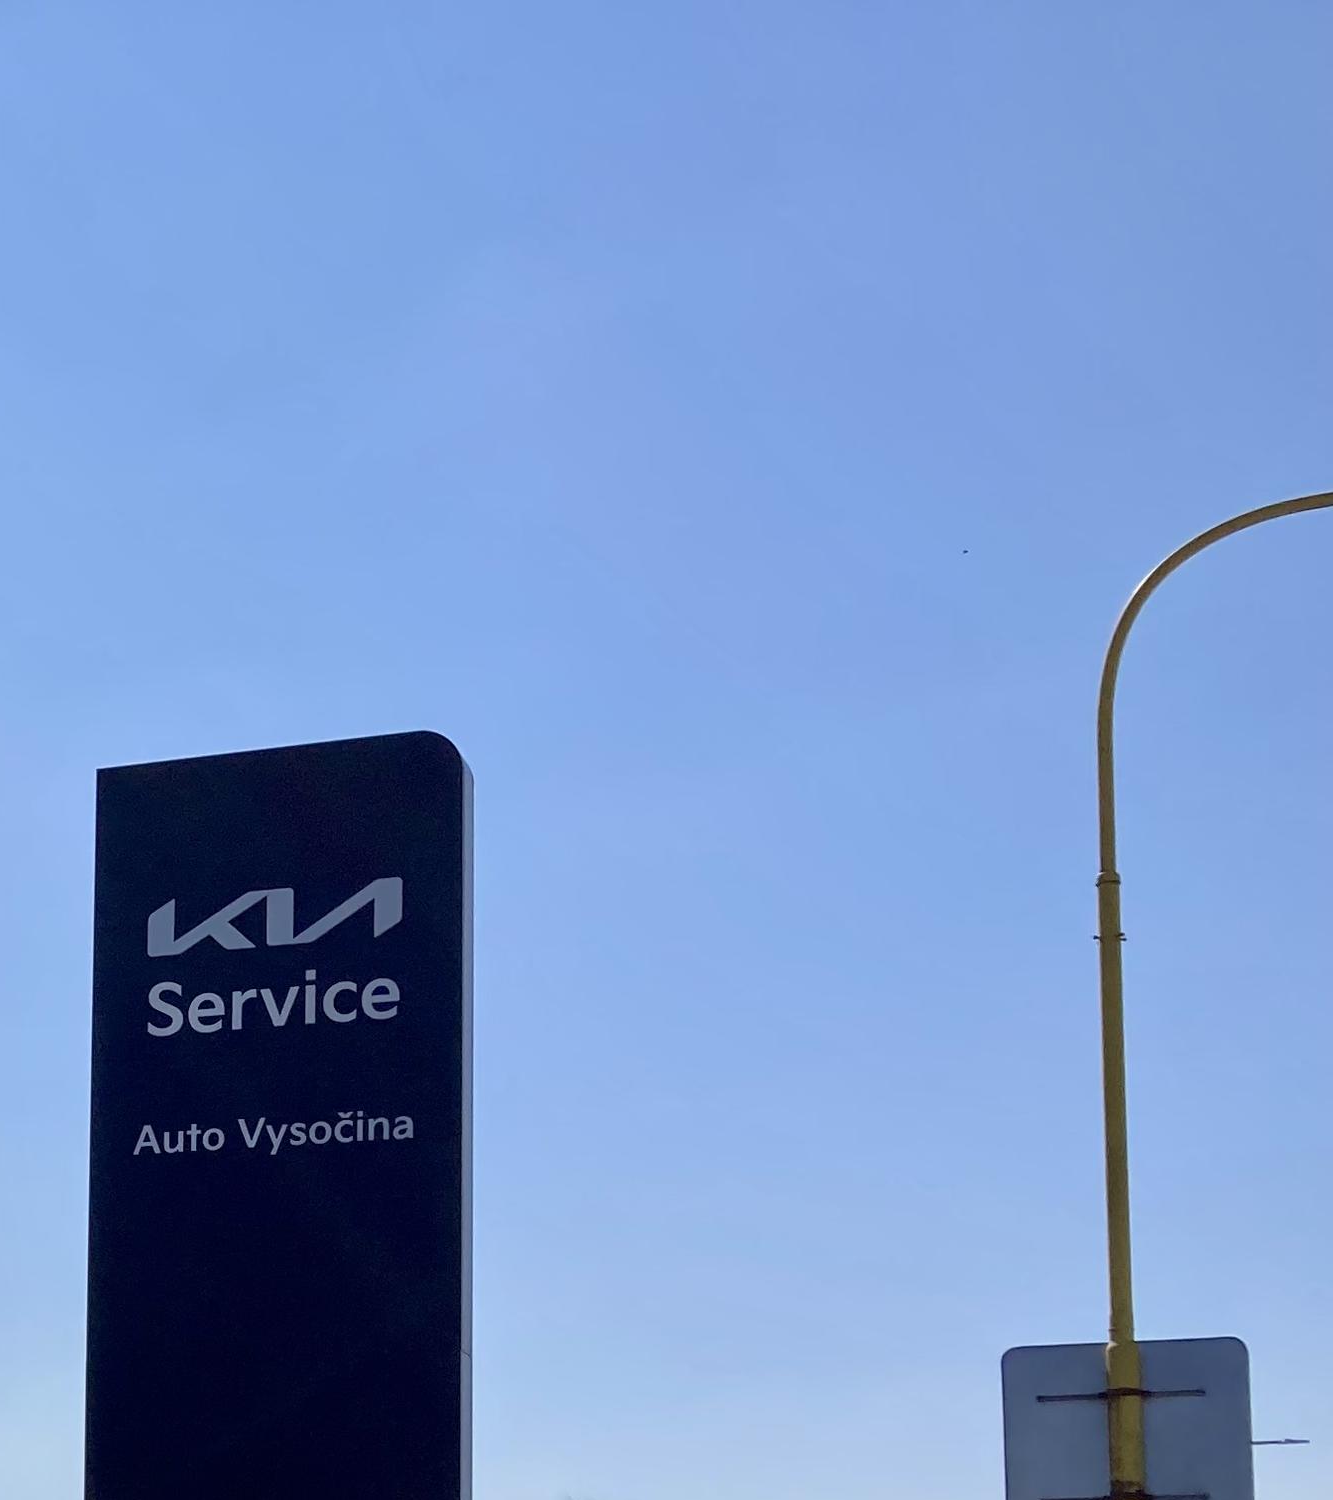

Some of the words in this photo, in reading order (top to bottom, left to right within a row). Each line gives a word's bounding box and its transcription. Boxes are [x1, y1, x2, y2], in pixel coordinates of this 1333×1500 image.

[147, 876, 404, 957] KIA
[147, 969, 400, 1036] Service
[133, 1123, 225, 1155] Auto
[238, 1110, 414, 1155] Vysočina
